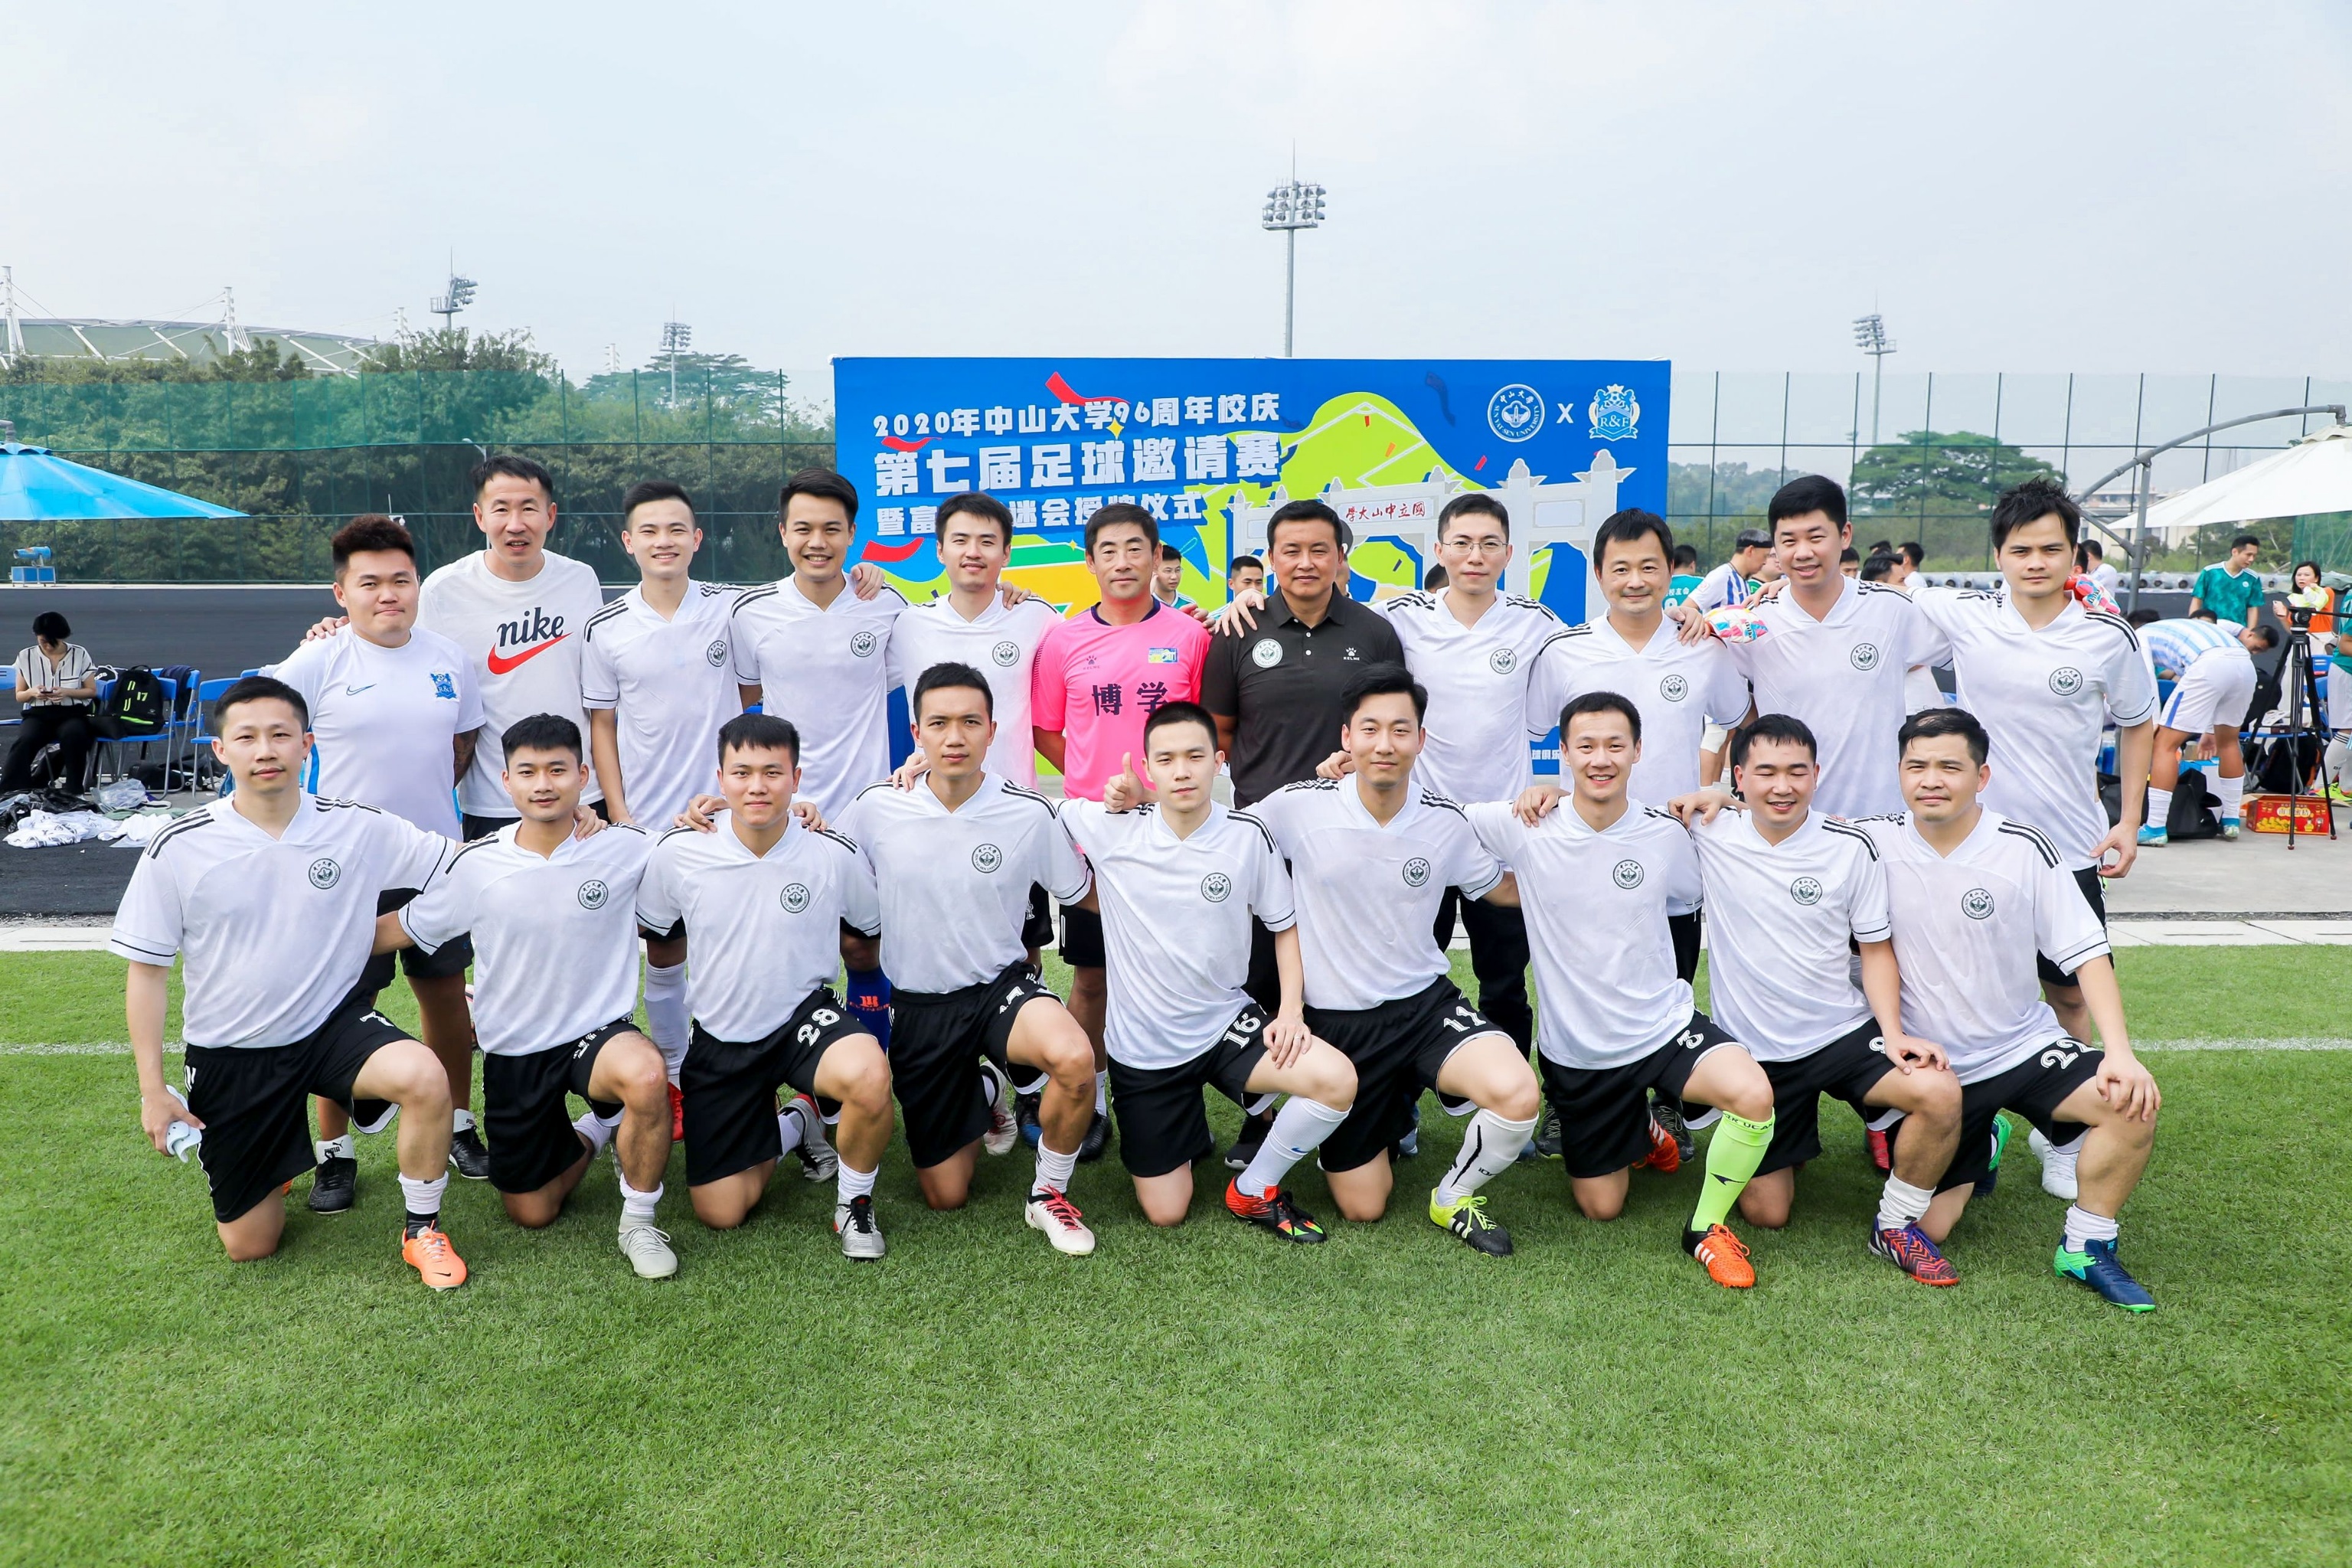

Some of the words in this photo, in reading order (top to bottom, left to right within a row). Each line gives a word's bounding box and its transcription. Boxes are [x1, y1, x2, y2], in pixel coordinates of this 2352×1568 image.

[873, 392, 1279, 436] 2020年中山大学96周年校庆
[1494, 419, 1514, 437] YAT-SEN
[1516, 405, 1539, 437] UNIVERSITY
[1600, 416, 1628, 428] R&F
[875, 433, 1280, 497] 第七届足球邀请赛
[497, 607, 564, 647] nike
[136, 691, 148, 701] 17
[1092, 681, 1168, 716] 博学
[797, 1008, 840, 1047] 28
[1223, 1012, 1261, 1049] 16
[1444, 1006, 1486, 1032] 11
[2040, 1039, 2099, 1069] 22
